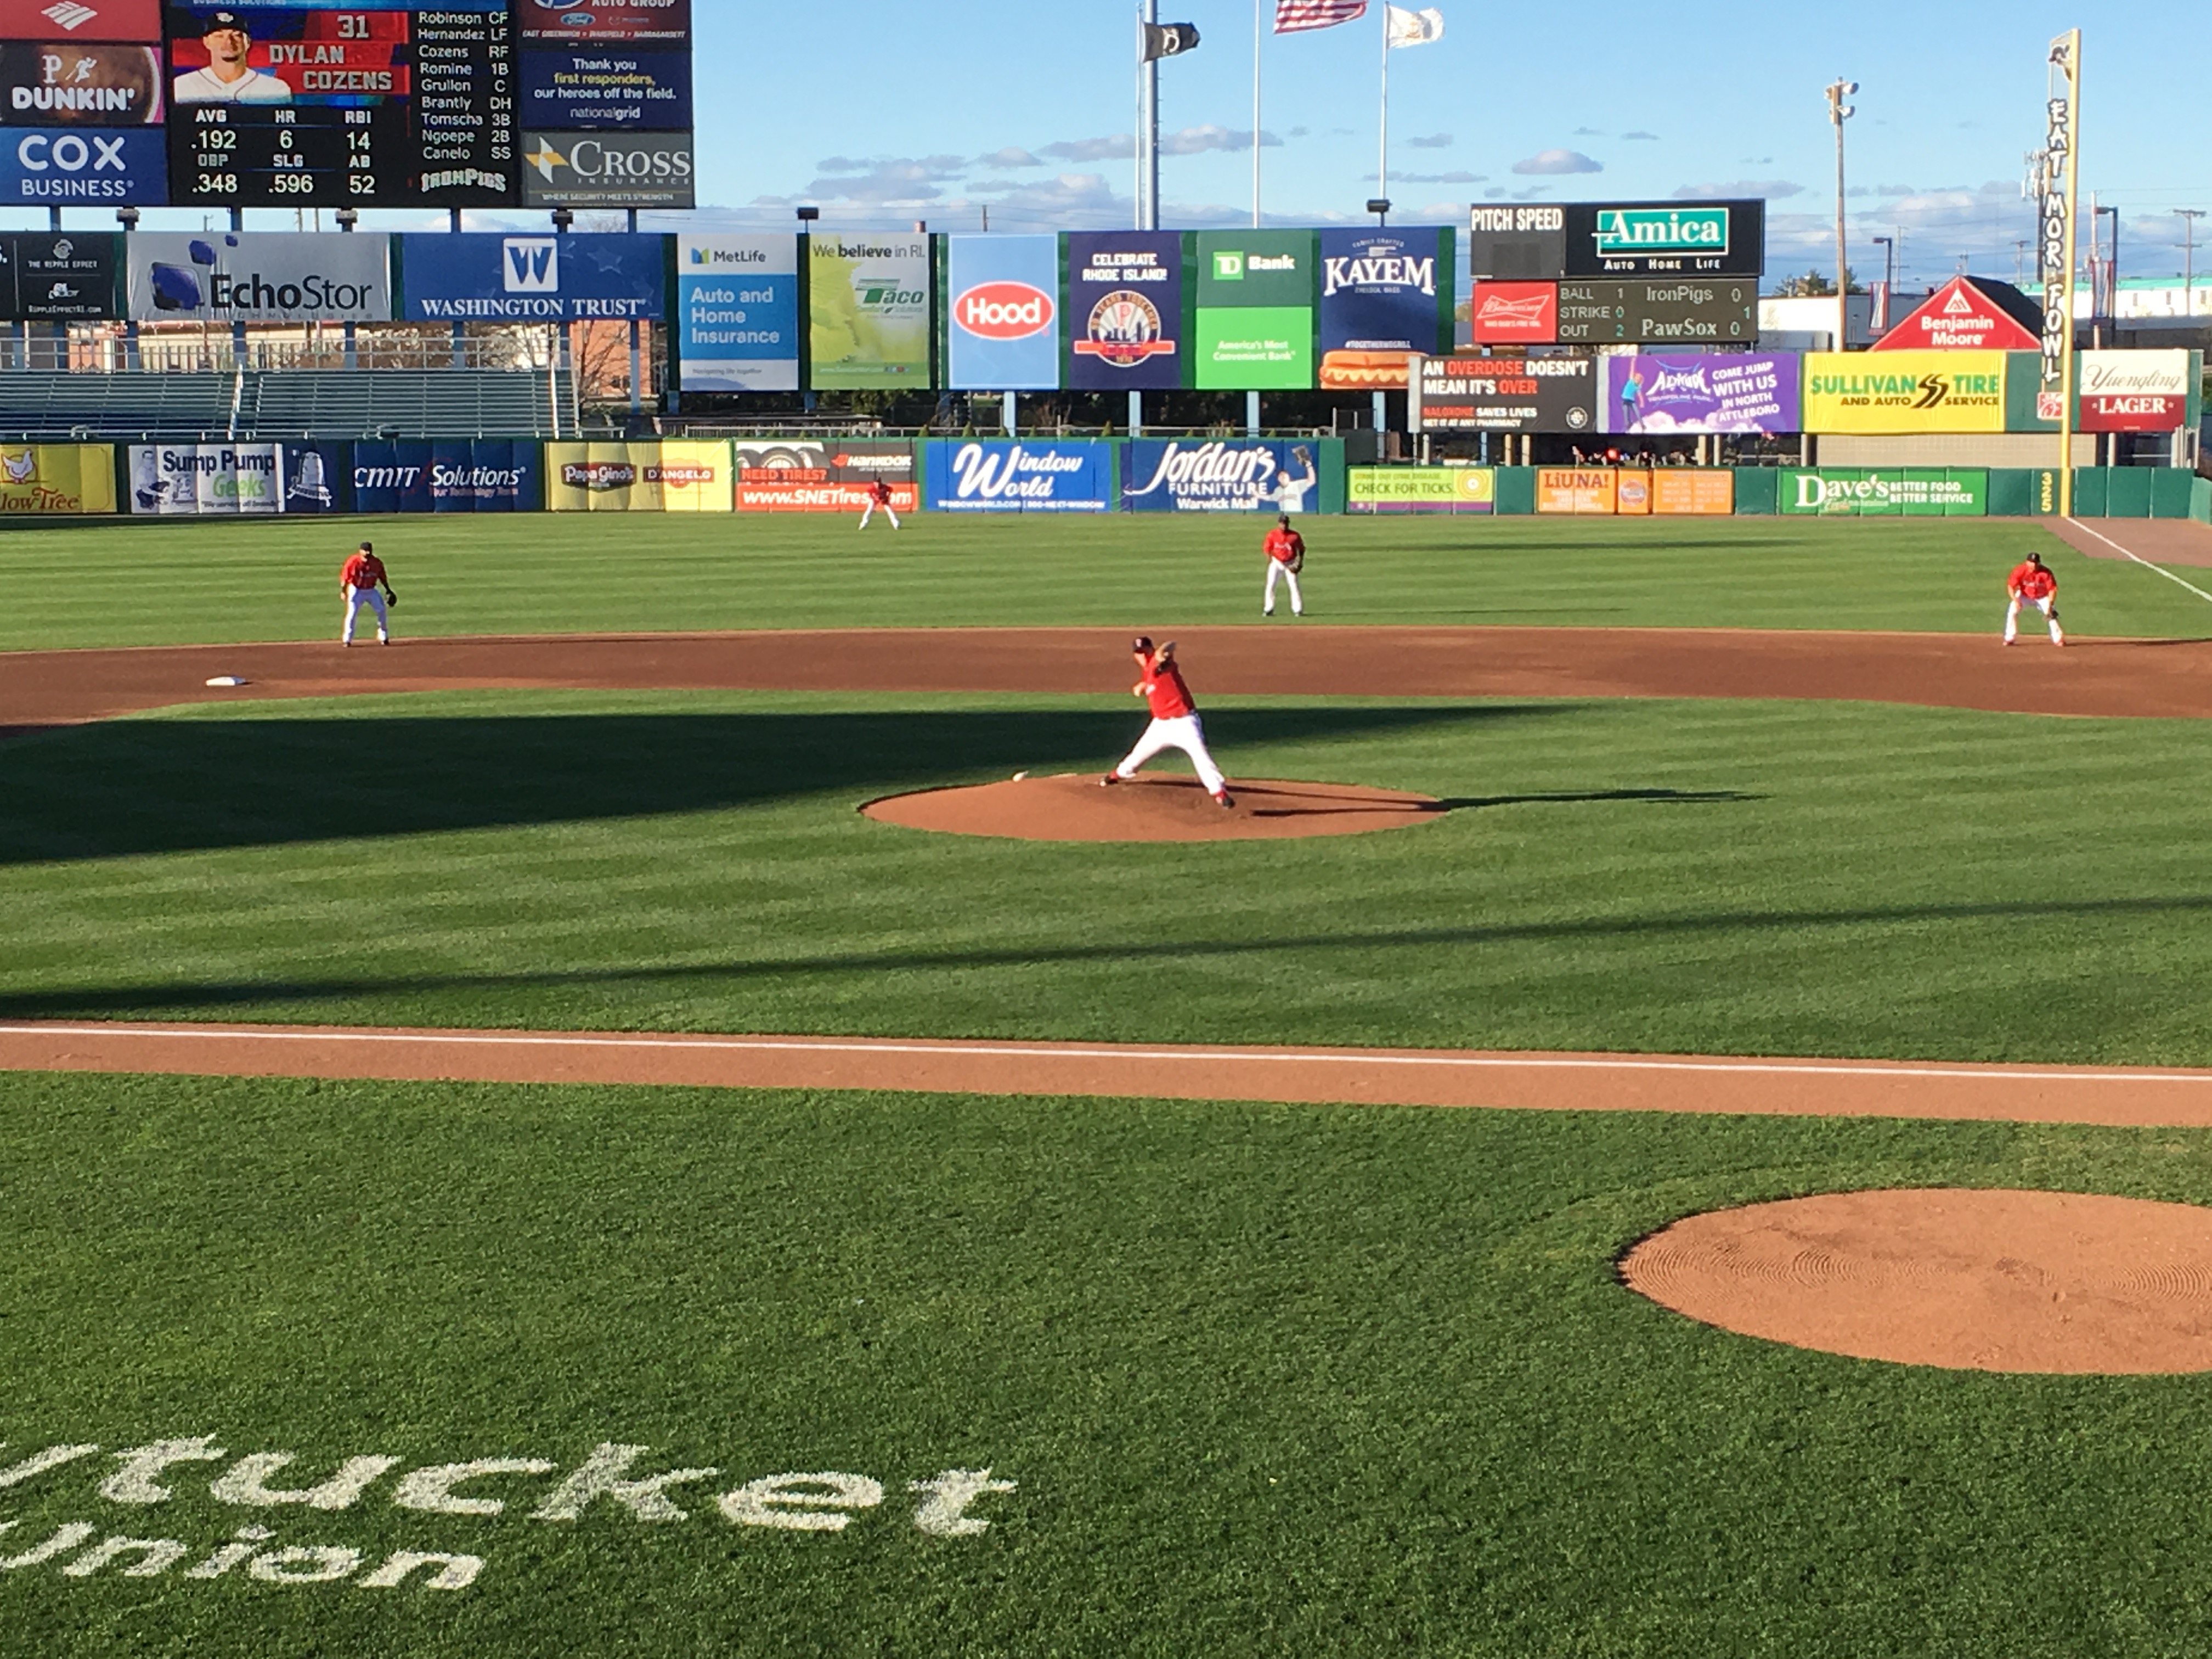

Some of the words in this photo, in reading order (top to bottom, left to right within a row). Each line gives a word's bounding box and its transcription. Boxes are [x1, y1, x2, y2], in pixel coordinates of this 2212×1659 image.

[337, 15, 369, 38] 31
[419, 12, 481, 25] Robinson
[488, 12, 509, 24] CF
[417, 29, 485, 41] Hernandez
[490, 29, 507, 41] LF
[269, 45, 345, 64] DYLAN
[419, 46, 469, 58] Cozens
[489, 46, 509, 58] RF
[420, 63, 472, 75] Romine
[491, 63, 509, 75] 1B
[573, 58, 611, 70] Thank
[613, 60, 637, 72] you
[303, 71, 392, 90] COZENS
[421, 79, 471, 92] Grullon
[494, 80, 506, 93] C
[554, 73, 578, 84] first
[582, 74, 656, 86] responders,
[12, 87, 135, 109] DUNKIN'
[534, 89, 555, 99] our
[558, 87, 601, 99] heroes
[604, 87, 620, 99] off
[623, 87, 643, 99] the
[647, 88, 676, 99] field.
[421, 96, 471, 111] Brantly
[490, 97, 511, 110] DH
[195, 110, 227, 122] AVG
[275, 110, 296, 123] HR
[345, 111, 371, 124] RBI
[421, 113, 483, 126] Tomscha
[492, 114, 511, 126] 3B
[570, 106, 640, 121] nationalgrid
[190, 130, 236, 149] .192
[280, 131, 292, 149] 6
[347, 132, 371, 150] 14
[422, 130, 475, 144] Ngoepe
[492, 130, 510, 143] 2B
[2048, 99, 2068, 177] EAT
[18, 135, 126, 171] COX
[198, 154, 228, 166] OBP
[273, 154, 303, 167] SLG
[348, 155, 370, 168] AB
[423, 147, 471, 160] Canelo
[491, 147, 511, 160] SS
[570, 140, 691, 176] CROSS
[21, 179, 126, 196] BUSINESS
[192, 174, 238, 193] .348
[268, 174, 313, 193] .596
[349, 175, 375, 194] 52
[421, 168, 506, 193] IRONPIGS
[1471, 209, 1513, 231] PITCH
[1516, 208, 1562, 230] SPEED
[1592, 211, 1720, 244] Amica
[2045, 193, 2066, 270] MOR
[713, 250, 766, 263] MetLife
[812, 245, 835, 258] We
[838, 245, 891, 258] believe
[895, 245, 907, 257] in
[1092, 253, 1157, 266] CELEBRATE
[1216, 256, 1241, 274] TD
[1249, 255, 1295, 270] Bank
[1604, 259, 1635, 270] AUTO
[1649, 259, 1681, 270] HOME
[1696, 258, 1720, 269] LIFE
[1082, 268, 1119, 281] RHODE
[1123, 268, 1167, 281] ISLAND!
[1323, 256, 1435, 296] KAYEM
[210, 274, 373, 310] EchoStor
[690, 287, 735, 303] Auto
[740, 286, 774, 303] and
[855, 278, 924, 303] Taco
[1560, 287, 1593, 300] BALL
[1617, 287, 1623, 299] 1
[1646, 286, 1713, 304] IronPigs
[1731, 288, 1742, 302] 0
[421, 299, 563, 317] WASHINGTON
[572, 298, 640, 316] TRUST
[967, 297, 1040, 324] Hood
[1483, 301, 1541, 313] Budweiser
[1560, 307, 1610, 318] STRIKE
[1615, 306, 1624, 318] 0
[1743, 306, 1751, 319] 1
[691, 308, 746, 323] Home
[1922, 314, 1994, 332] Benjamin
[1560, 325, 1588, 336] OUT
[1616, 325, 1624, 337] 2
[1641, 318, 1717, 336] PawSox
[1730, 321, 1740, 335] 0
[2045, 283, 2063, 382] FOWL
[691, 329, 780, 344] Insurance
[1932, 331, 1982, 345] Moore
[1218, 340, 1262, 350] America's
[1264, 340, 1289, 350] Most
[1213, 352, 1266, 361] Convenient
[1423, 360, 1444, 376] AN
[1448, 360, 1523, 375] OVERDOSE
[1526, 360, 1589, 376] DOESN'T
[1712, 366, 1742, 380] COME
[1745, 362, 1774, 375] JUMP
[1712, 379, 1753, 397] WITH
[1756, 374, 1777, 389] US
[1811, 374, 1917, 394] SULLIVAN
[1953, 374, 1999, 394] TIRE
[2082, 364, 2186, 392] Yuengling
[1424, 380, 1466, 394] MEAN
[1470, 380, 1496, 394] IT'S
[1499, 380, 1537, 394] OVER
[1722, 399, 1733, 408] IN
[1735, 392, 1772, 407] NORTH
[1841, 397, 1870, 405] AND
[1875, 397, 1911, 405] AUTO
[1945, 397, 1999, 405] SERVICE
[2099, 398, 2166, 414] LAGER
[1424, 407, 1474, 417] NALOXONE
[1476, 407, 1506, 417] SAVES
[1509, 407, 1537, 417] LIVES
[1719, 404, 1780, 421] ATTLEBORO
[1477, 419, 1521, 427] PHARMACY
[163, 451, 216, 476] Sump
[221, 450, 274, 476] Pump
[953, 443, 1084, 498] Window
[1124, 442, 1276, 494] Jordan's
[432, 465, 520, 487] Solutions
[565, 466, 597, 482] Papa
[599, 466, 633, 482] Gino's
[742, 470, 778, 480] NEED
[781, 470, 827, 480] TIRES?
[1544, 472, 1609, 488] LiUNA!
[213, 475, 266, 498] Geeks
[1169, 482, 1267, 495] FURNITURE
[1355, 483, 1391, 493] CHECK
[1395, 483, 1417, 493] FOR
[1795, 474, 1889, 506] Dave's
[1891, 482, 1927, 492] BETTER
[1931, 482, 1961, 492] FOOD
[2041, 472, 2052, 512] 325
[32, 487, 79, 509] Tree
[1177, 498, 1228, 509] Warwick
[1232, 498, 1258, 509] Mall
[1891, 494, 1927, 503] BETTER
[1930, 494, 1973, 503] SERVICE
